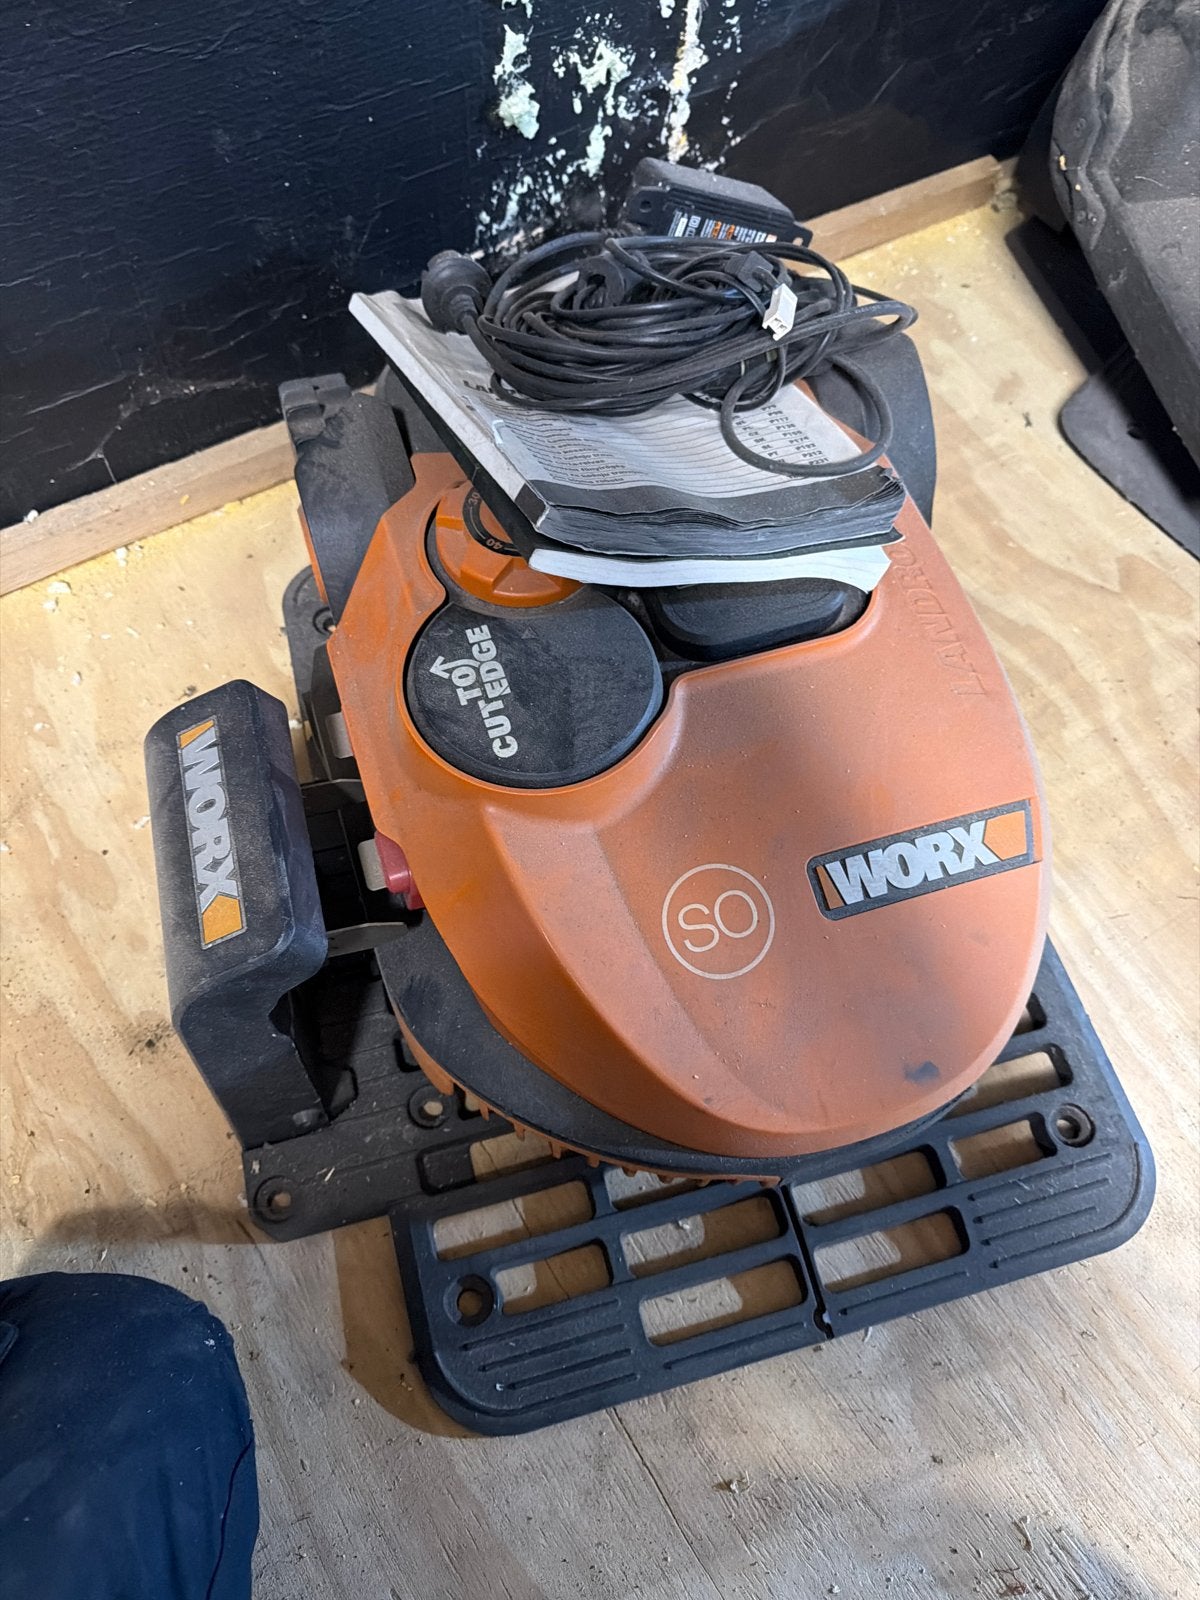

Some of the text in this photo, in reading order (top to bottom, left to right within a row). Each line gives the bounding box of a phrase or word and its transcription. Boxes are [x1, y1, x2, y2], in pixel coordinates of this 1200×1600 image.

[468, 491, 480, 506] 30
[486, 538, 503, 550] 40
[451, 665, 483, 706] TO
[465, 624, 519, 758] CUT EDGE
[181, 726, 240, 914] WORX
[825, 819, 1001, 906] WORX
